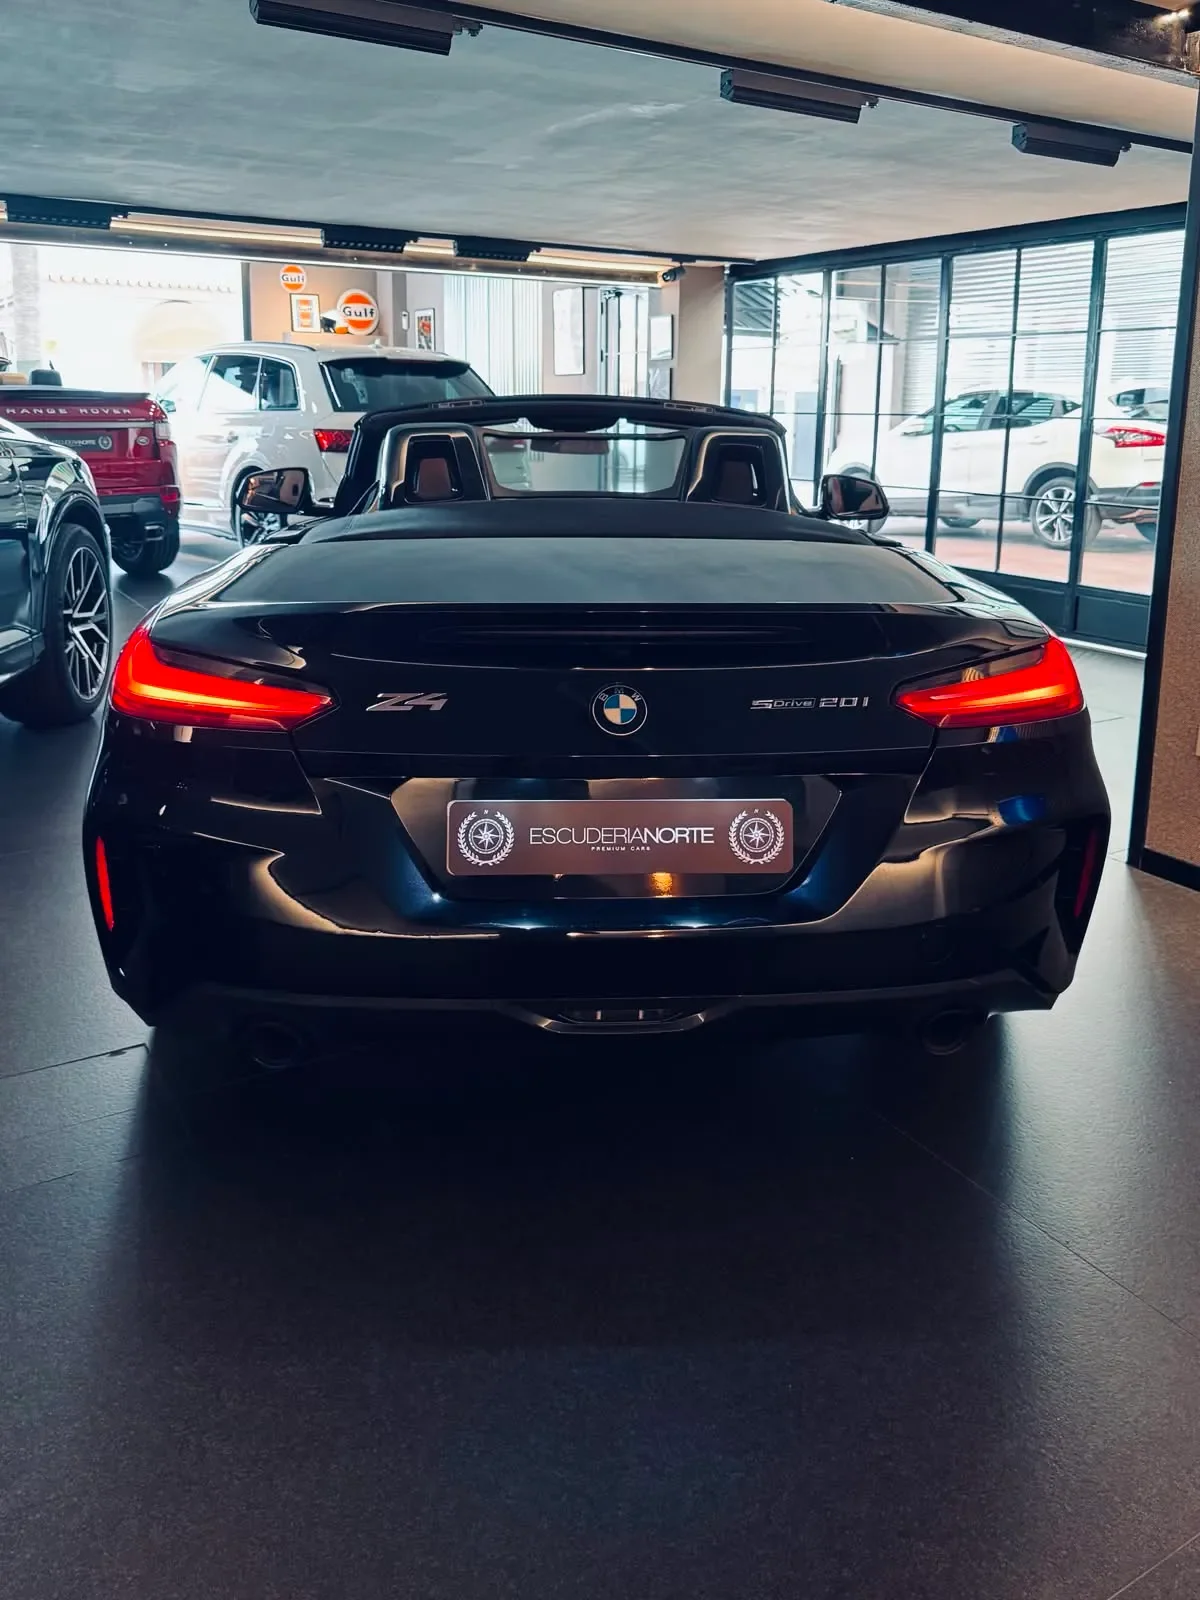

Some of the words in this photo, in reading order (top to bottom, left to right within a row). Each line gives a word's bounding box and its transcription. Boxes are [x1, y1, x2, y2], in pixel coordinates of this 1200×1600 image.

[281, 273, 305, 282] Gulf
[342, 305, 376, 318] Gulf
[365, 692, 448, 711] Z4
[597, 687, 642, 702] BMW
[529, 827, 715, 845] ESCUDERIANORTE
